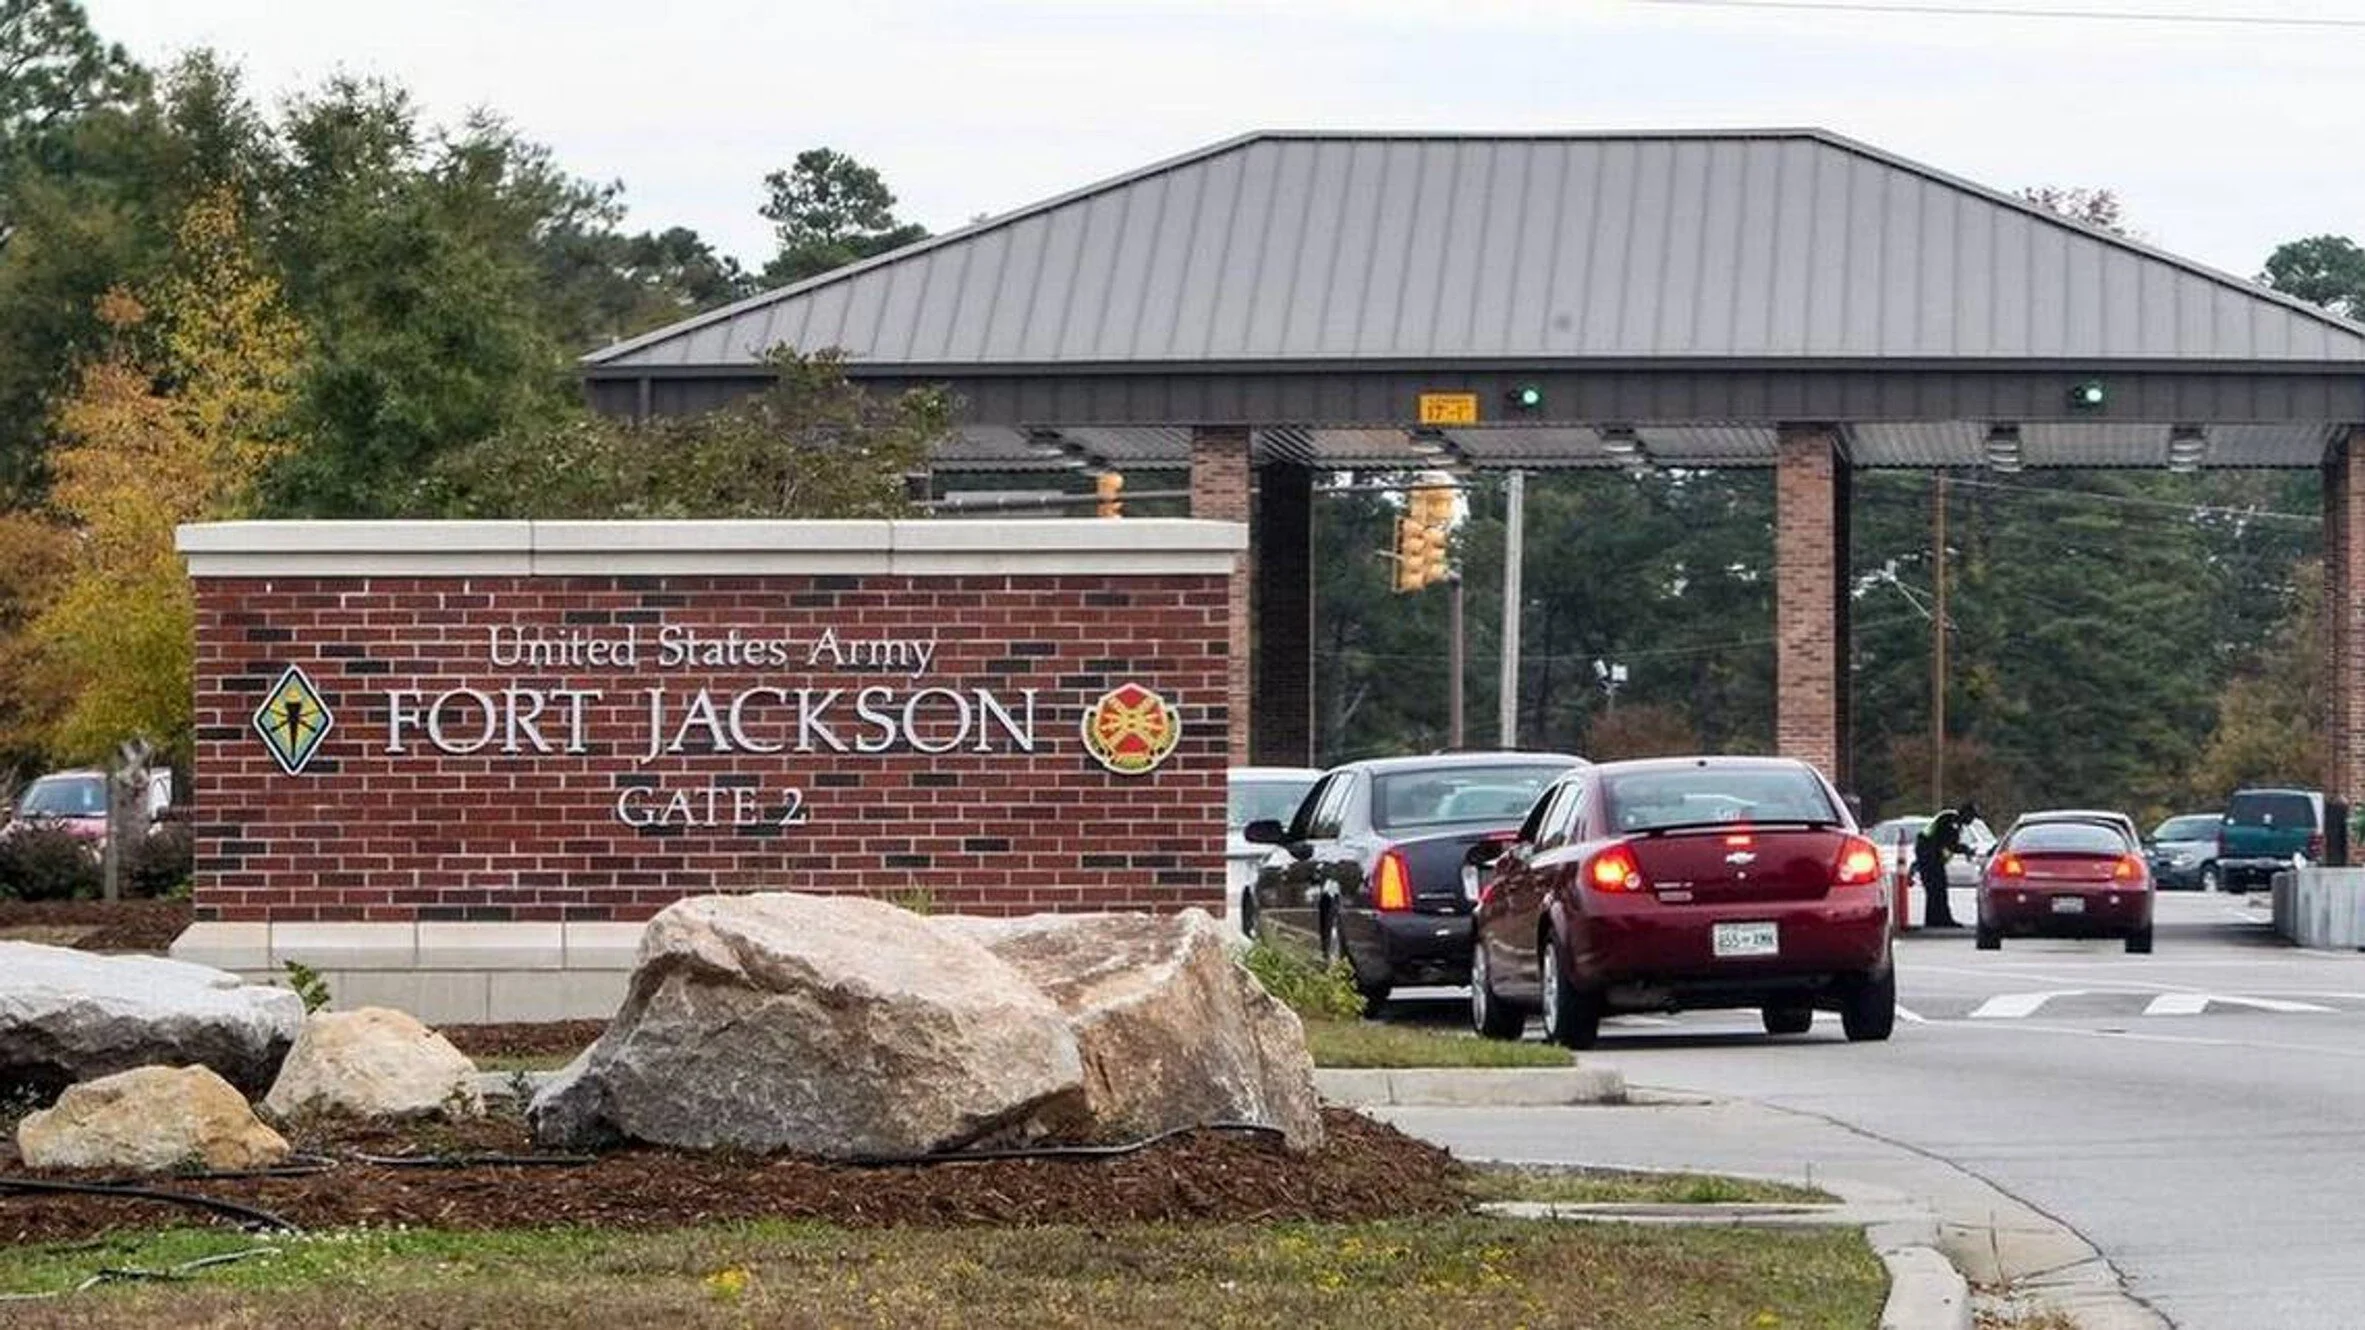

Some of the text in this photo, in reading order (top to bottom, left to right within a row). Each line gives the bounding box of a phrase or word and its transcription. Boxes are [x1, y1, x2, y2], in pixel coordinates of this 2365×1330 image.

[487, 624, 936, 679] United States Army
[384, 686, 1039, 765] FORT JACKSON
[618, 786, 807, 827] GATE 2
